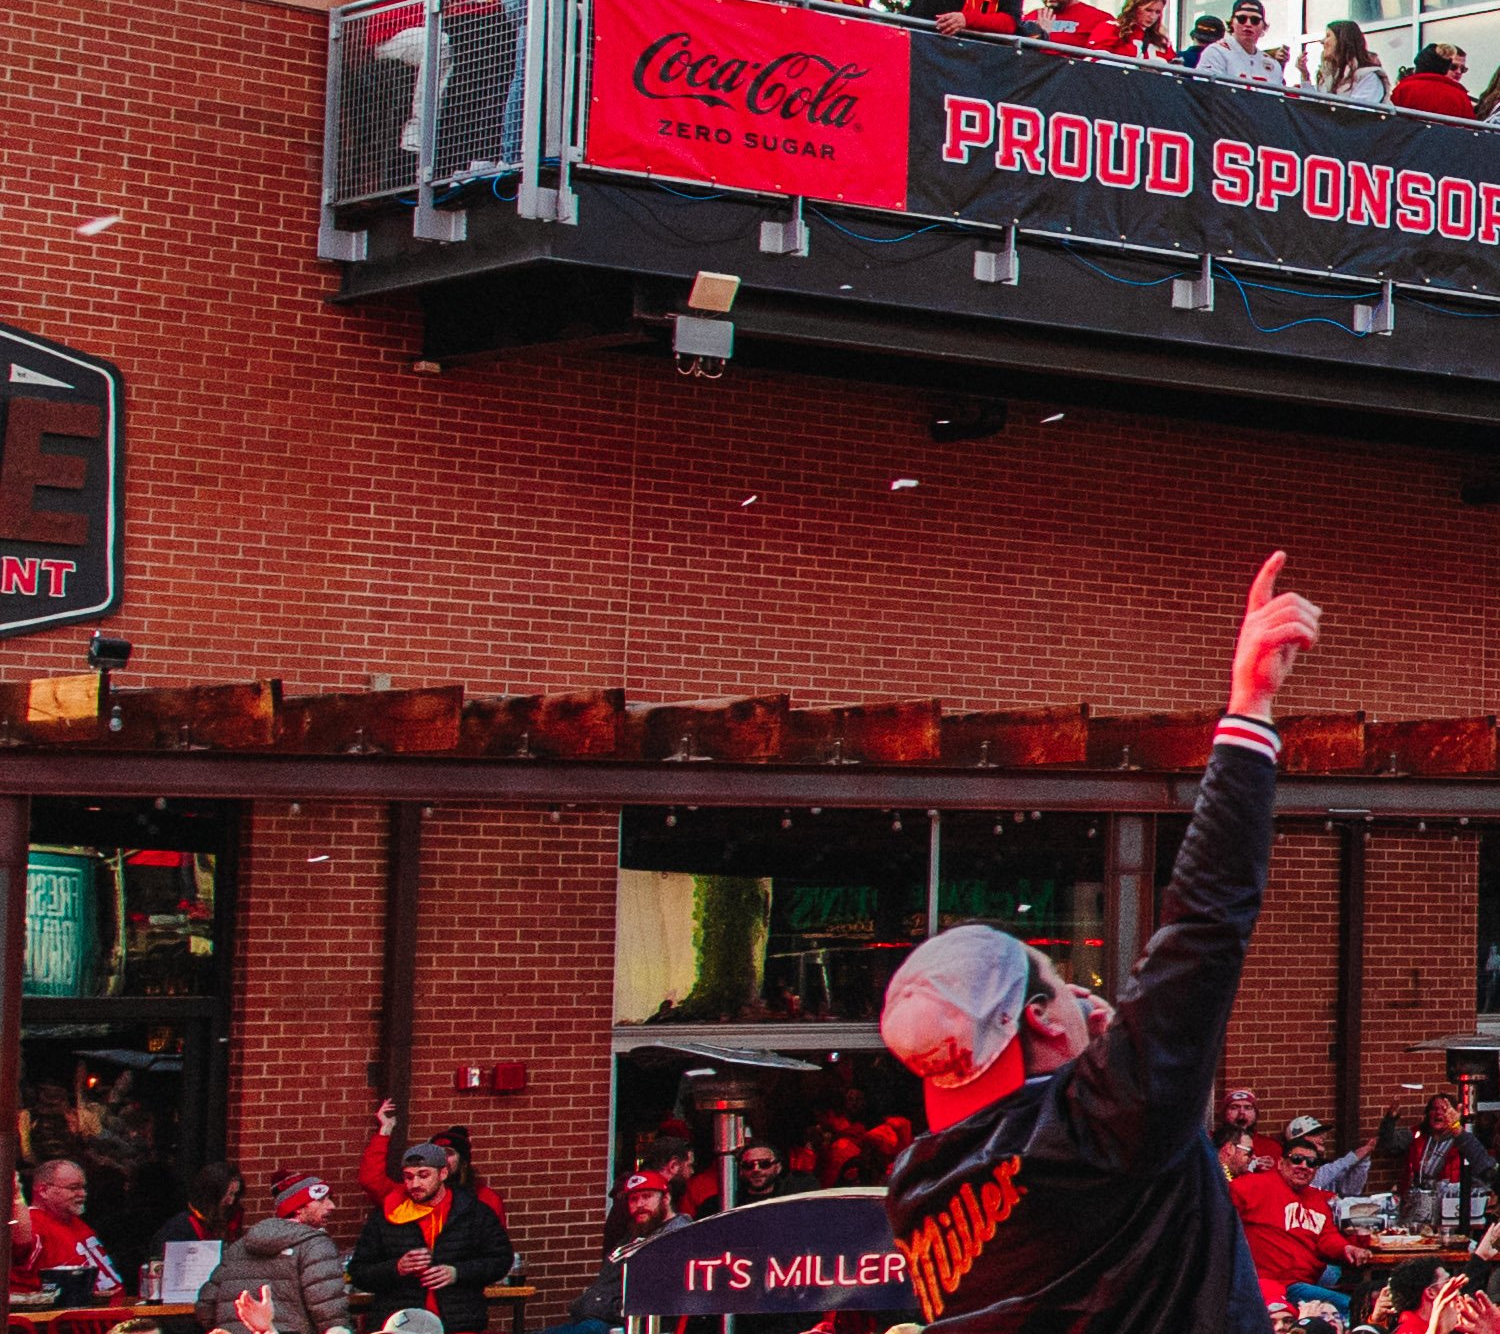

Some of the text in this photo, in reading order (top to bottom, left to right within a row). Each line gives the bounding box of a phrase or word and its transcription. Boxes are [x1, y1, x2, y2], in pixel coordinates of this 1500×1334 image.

[633, 33, 868, 129] Coca-Cola
[657, 119, 836, 161] ZERO SUGAR
[941, 93, 1194, 198] PROUD
[685, 1253, 915, 1293] IT'S MILLER
[895, 1154, 1025, 1326] Miller
